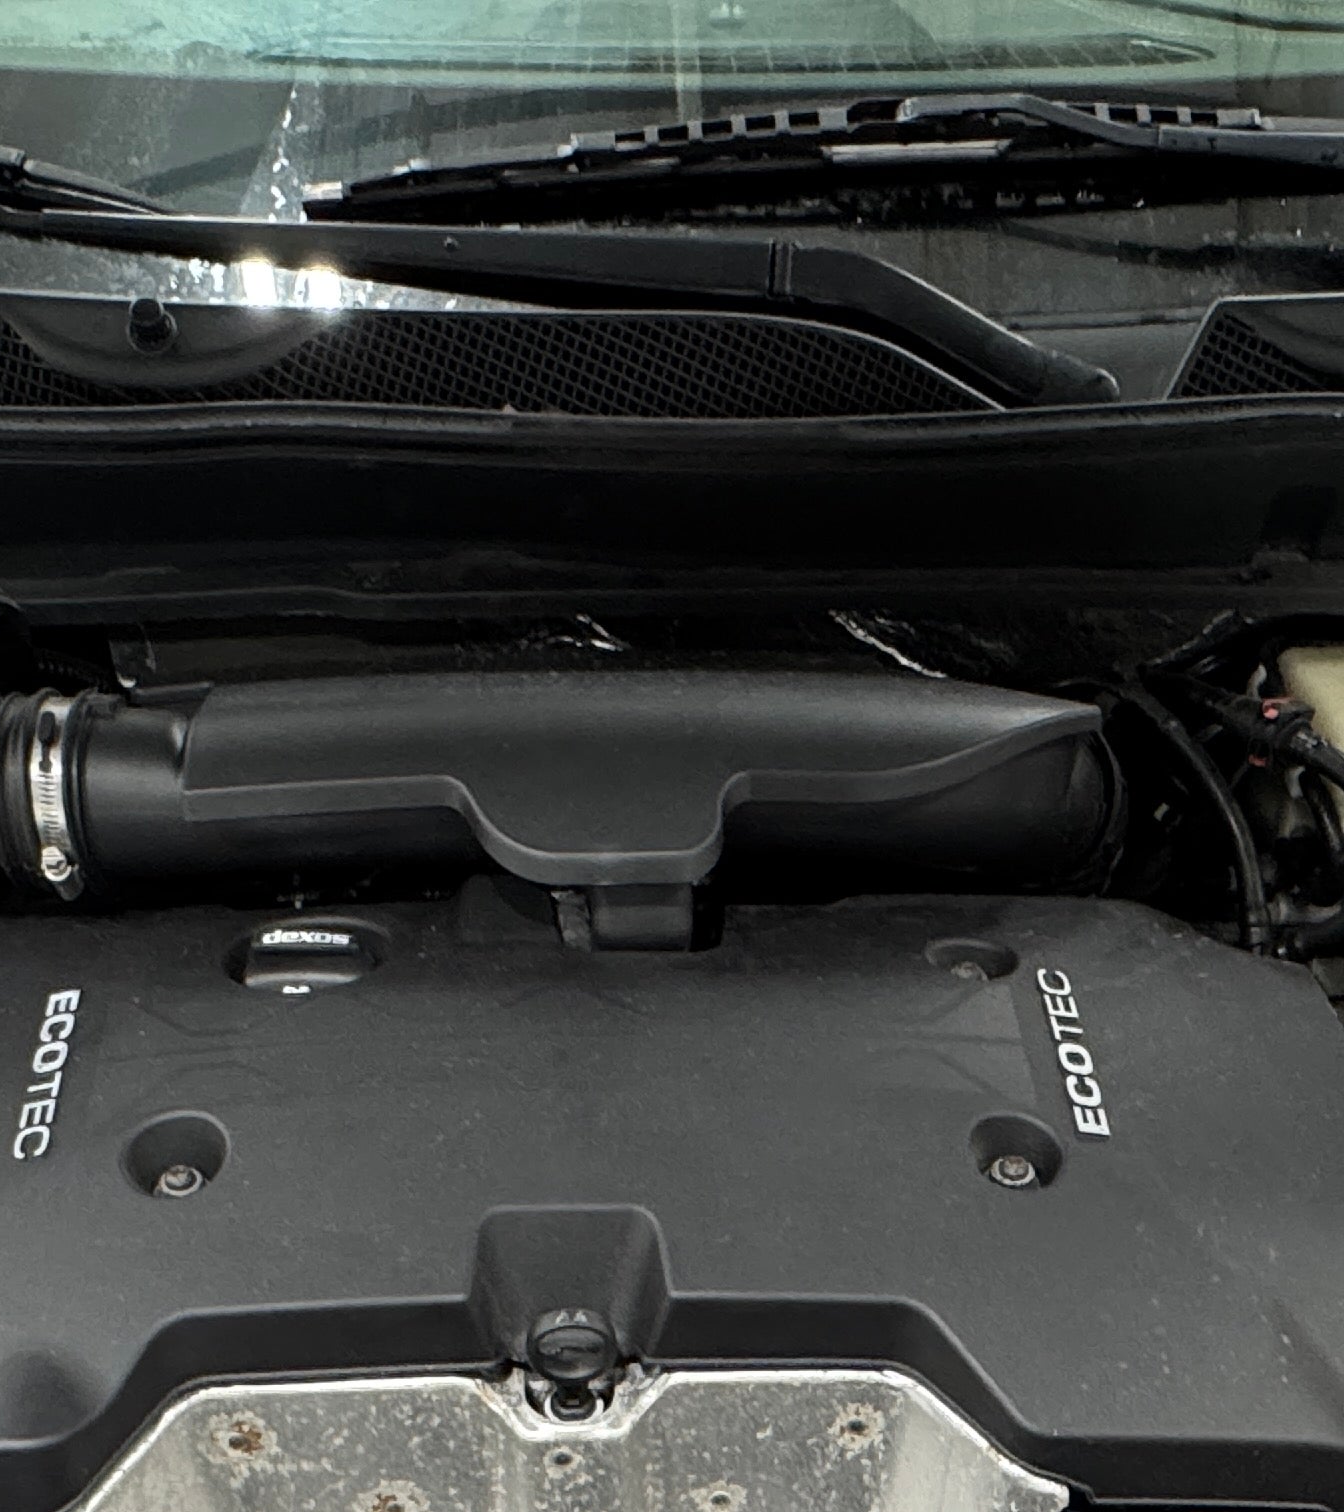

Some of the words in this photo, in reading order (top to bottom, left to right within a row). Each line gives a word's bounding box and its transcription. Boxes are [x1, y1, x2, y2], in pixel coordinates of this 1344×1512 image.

[262, 929, 351, 945] dexos
[13, 989, 81, 1160] ECOTEC
[1037, 968, 1111, 1136] ECOTEC
